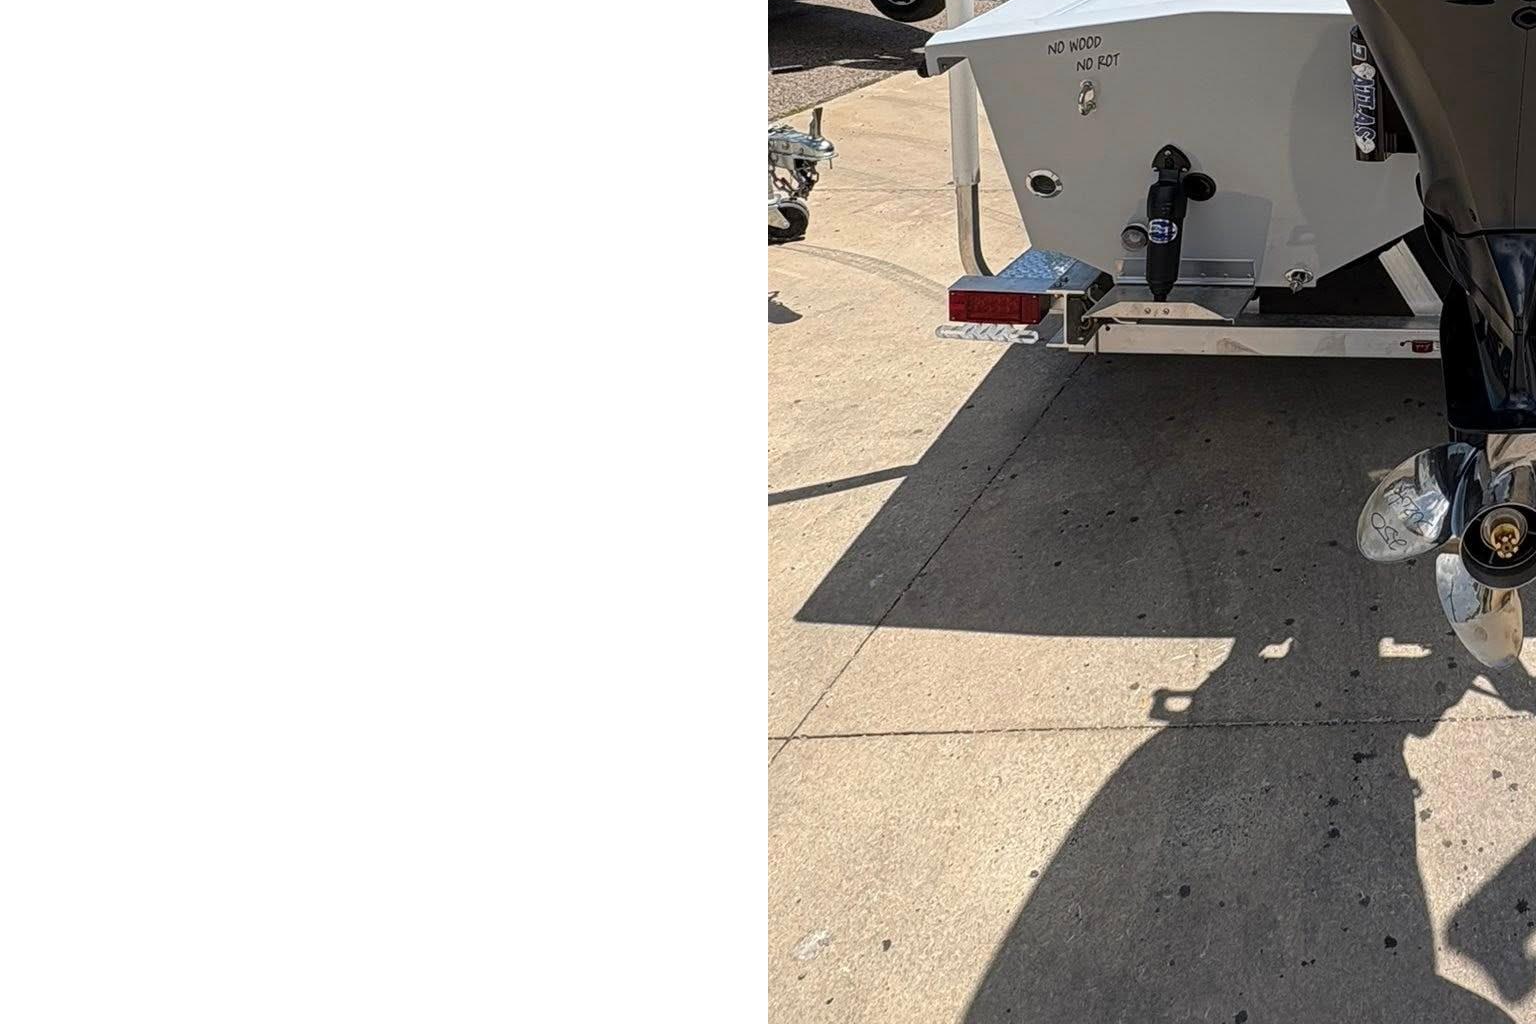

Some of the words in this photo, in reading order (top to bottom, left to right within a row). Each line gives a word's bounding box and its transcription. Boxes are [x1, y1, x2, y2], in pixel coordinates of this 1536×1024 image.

[1048, 41, 1065, 55] NO
[1069, 36, 1102, 53] WOOD
[1077, 58, 1093, 71] NO
[1098, 53, 1120, 70] ROT
[1353, 76, 1376, 143] ATLAS
